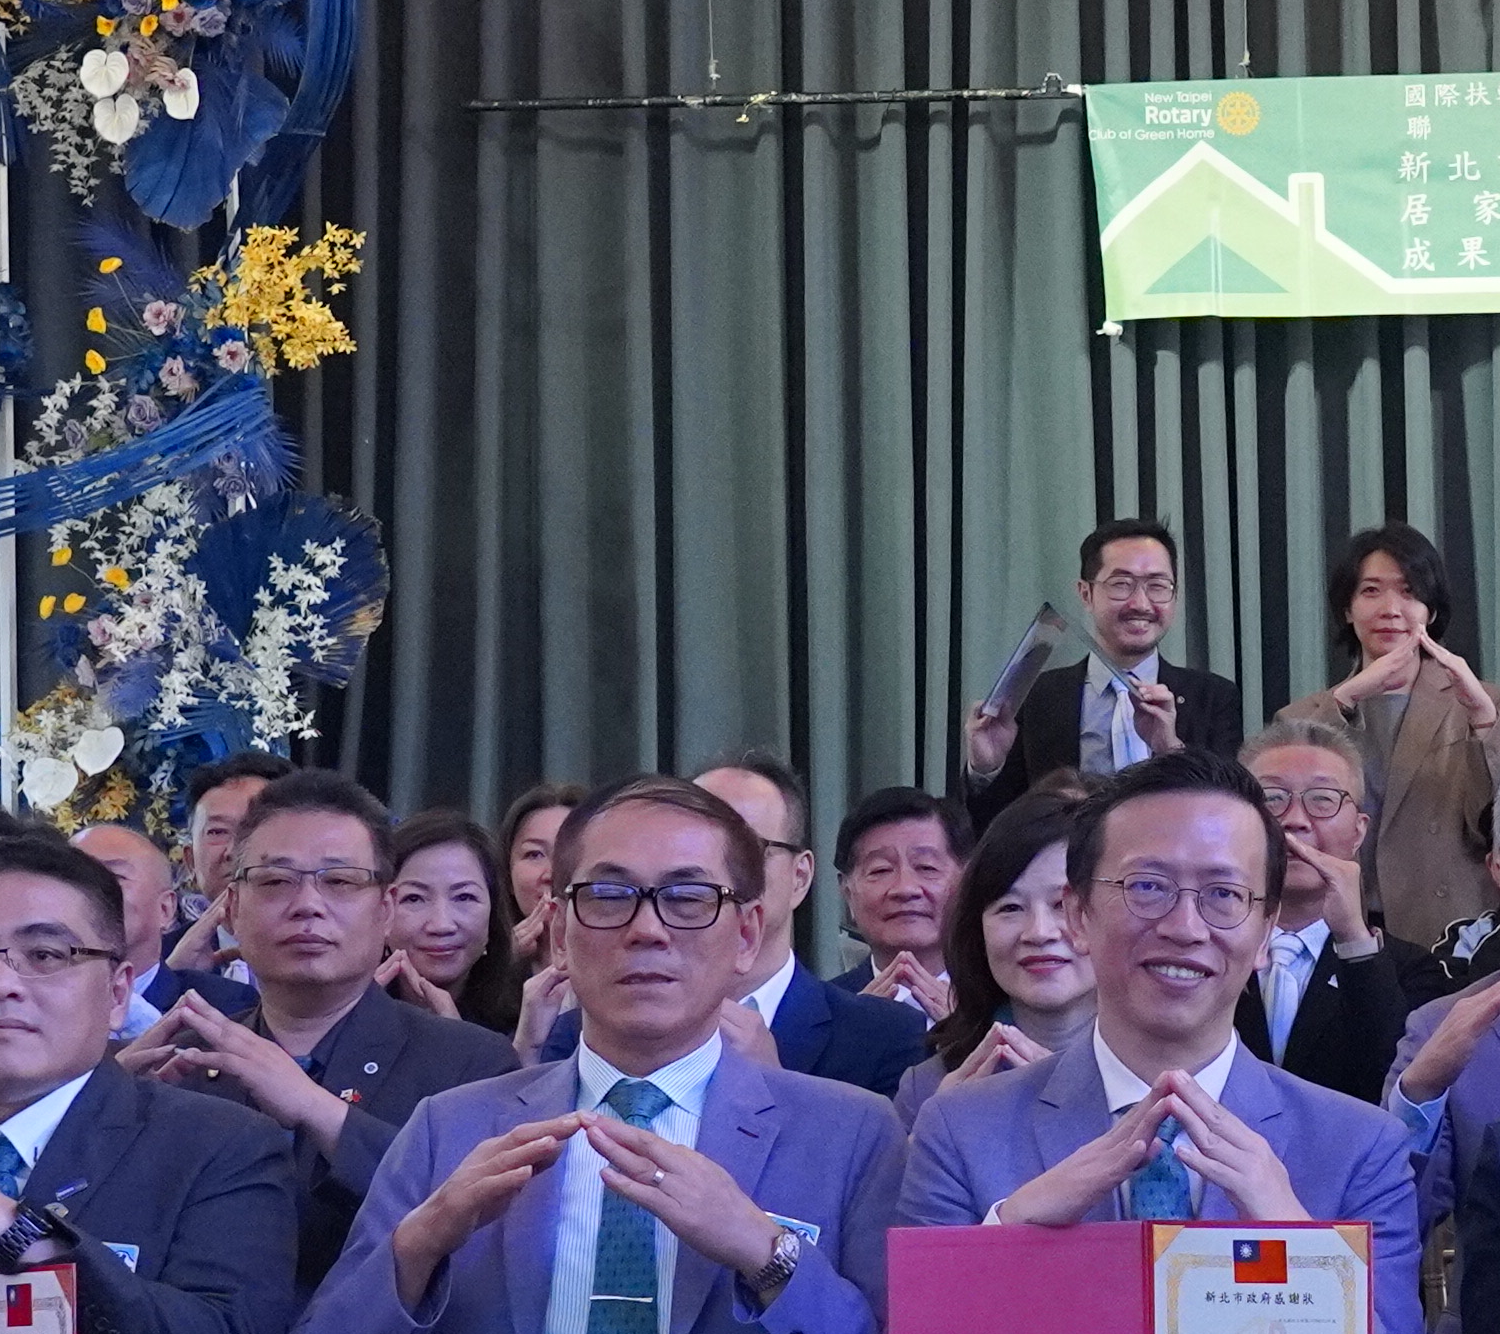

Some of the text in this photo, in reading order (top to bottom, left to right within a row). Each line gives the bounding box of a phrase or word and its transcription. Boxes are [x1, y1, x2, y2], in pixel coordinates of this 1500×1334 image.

[1145, 91, 1213, 104] New Taipei
[1145, 106, 1213, 126] Rotary
[1088, 128, 1215, 141] Club of Green Home
